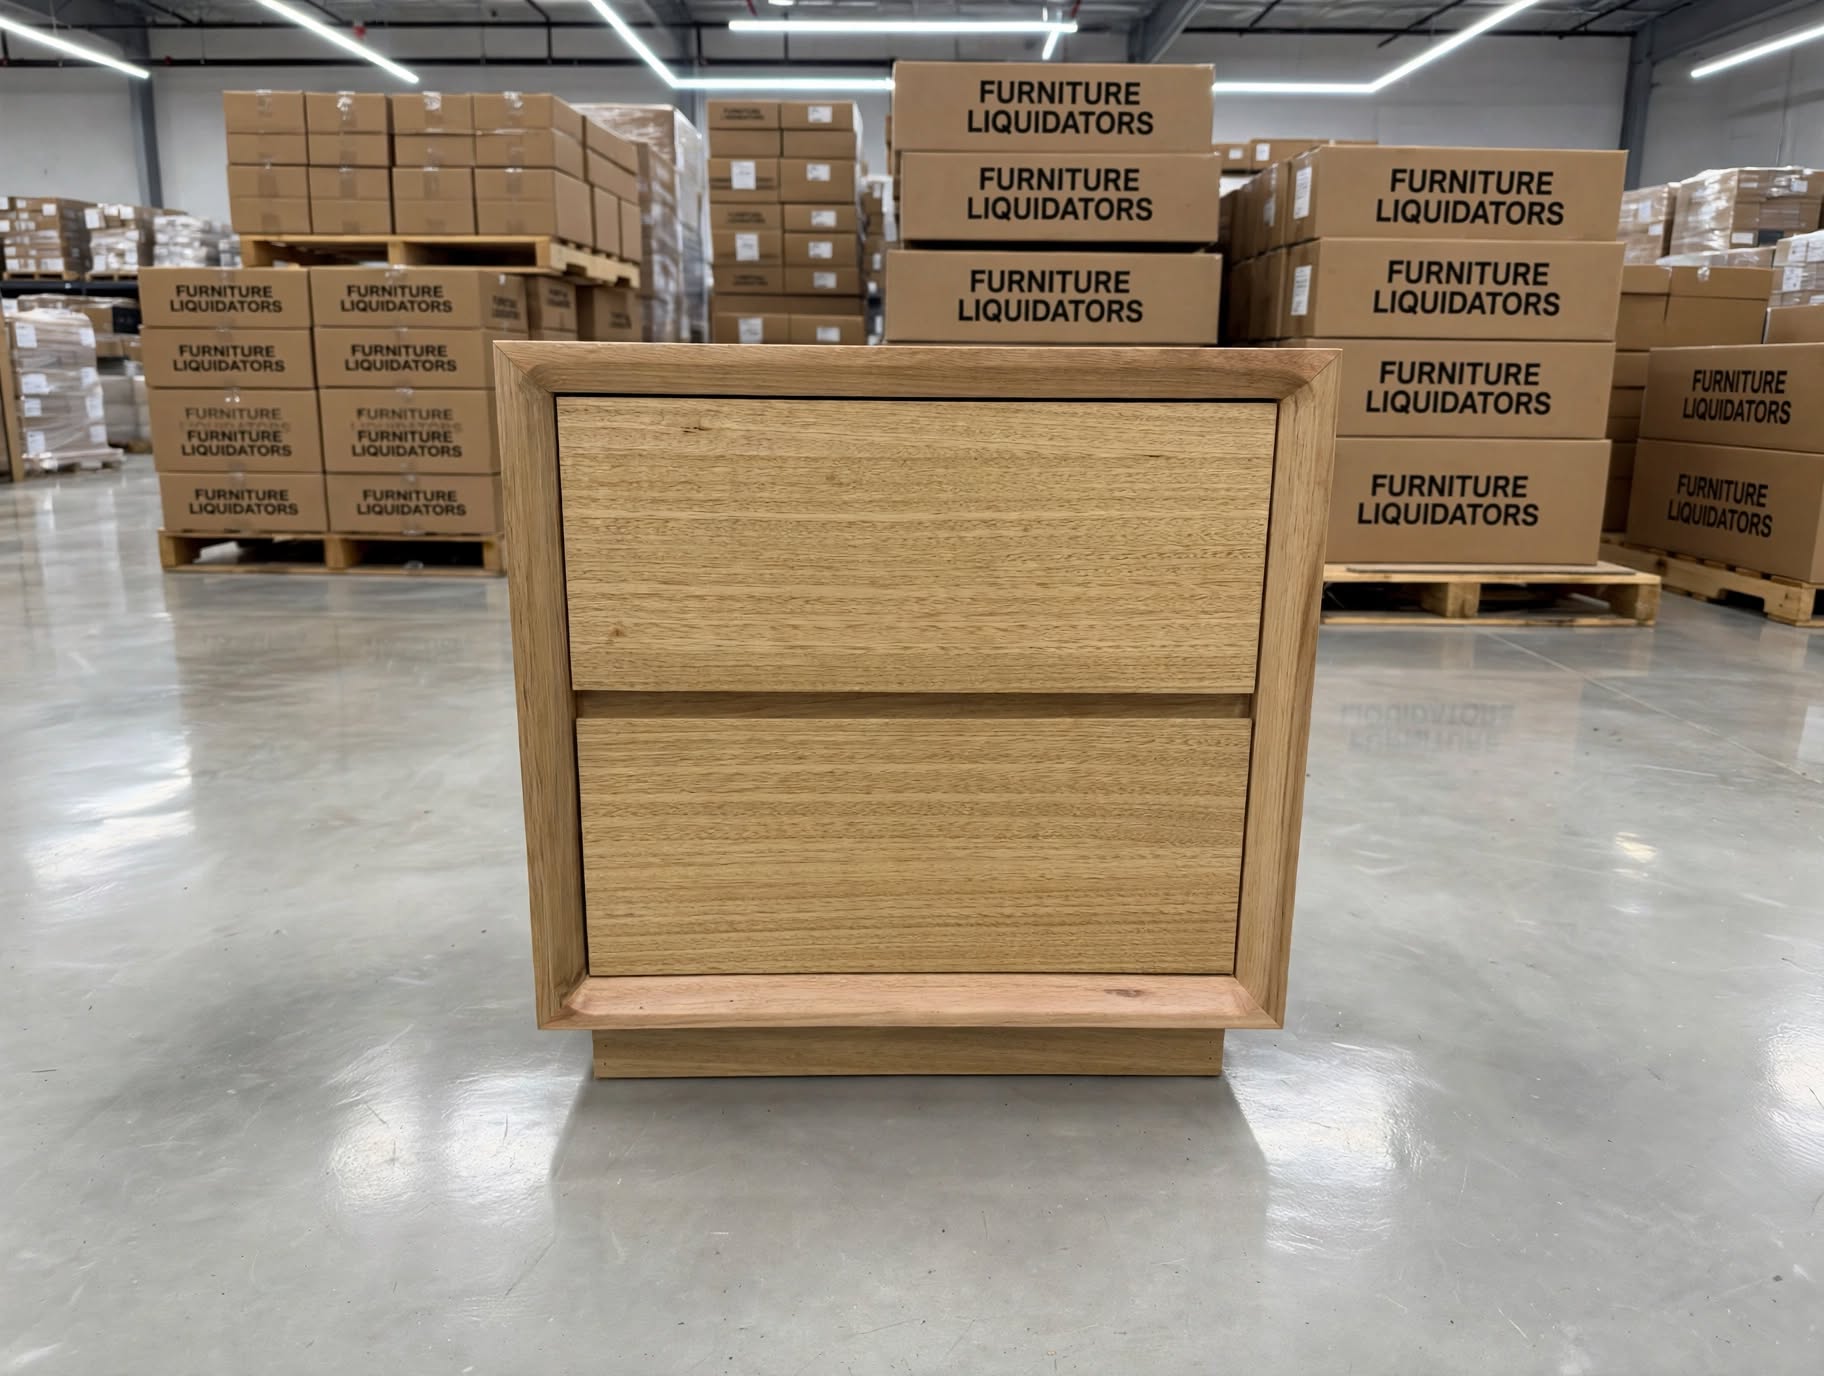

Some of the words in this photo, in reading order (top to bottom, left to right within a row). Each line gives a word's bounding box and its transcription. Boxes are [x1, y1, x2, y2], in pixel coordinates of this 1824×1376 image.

[979, 80, 1141, 105] FURNITURE
[967, 110, 1154, 135] LIQUIDATORS
[979, 167, 1140, 192] FURNITURE
[1390, 168, 1554, 195] FURNITURE
[967, 197, 1153, 222] LIQUIDATORS
[1376, 200, 1564, 225] LIQUIDATORS
[970, 269, 1130, 294] FURNITURE
[1388, 260, 1549, 285] FURNITURE
[175, 285, 273, 298] FURNITURE
[346, 285, 444, 298] FURNITURE
[169, 300, 282, 313] LIQUIDATORS
[340, 299, 453, 313] LIQUIDATORS
[957, 298, 1143, 323] LIQUIDATORS
[1373, 290, 1560, 316] LIQUIDATORS
[179, 344, 276, 357] FURNITURE
[351, 344, 448, 357] FURNITURE
[172, 359, 285, 372] LIQUIDATORS
[344, 358, 457, 371] LIQUIDATORS
[1379, 361, 1541, 386] FURNITURE
[1692, 369, 1788, 394] FURNITURE
[1365, 390, 1552, 415] LIQUIDATORS
[1682, 398, 1791, 425] LIQUIDATORS
[185, 407, 282, 420] FURNITURE
[356, 407, 453, 420] FURNITURE
[187, 430, 282, 443] FURNITURE
[357, 430, 454, 444] FURNITURE
[181, 444, 292, 456] LIQUIDATORS
[351, 444, 462, 457] LIQUIDATORS
[194, 489, 289, 501] FURNITURE
[363, 490, 458, 502] FURNITURE
[1371, 474, 1528, 499] FURNITURE
[1676, 472, 1769, 508] FURNITURE
[189, 503, 299, 515] LIQUIDATORS
[356, 503, 466, 516] LIQUIDATORS
[1357, 503, 1539, 527] LIQUIDATORS
[1667, 499, 1773, 538] LIQUIDATORS
